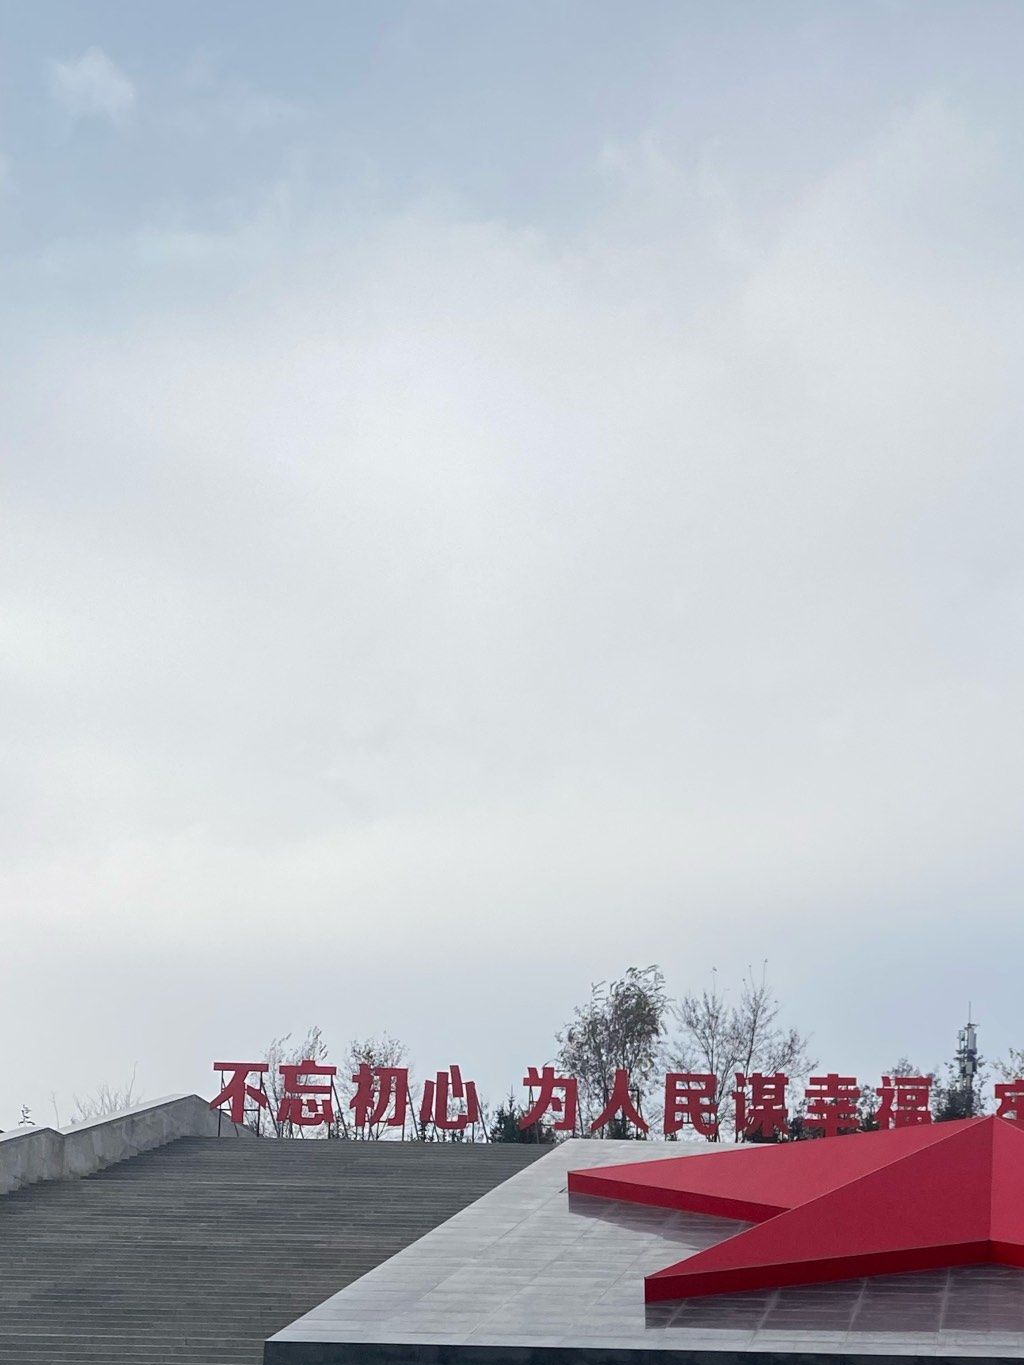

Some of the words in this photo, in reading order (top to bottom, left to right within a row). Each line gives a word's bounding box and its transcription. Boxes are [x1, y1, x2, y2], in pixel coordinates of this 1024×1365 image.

[210, 1059, 479, 1130] 不忘初心
[519, 1066, 933, 1138] 为人民谋幸福
